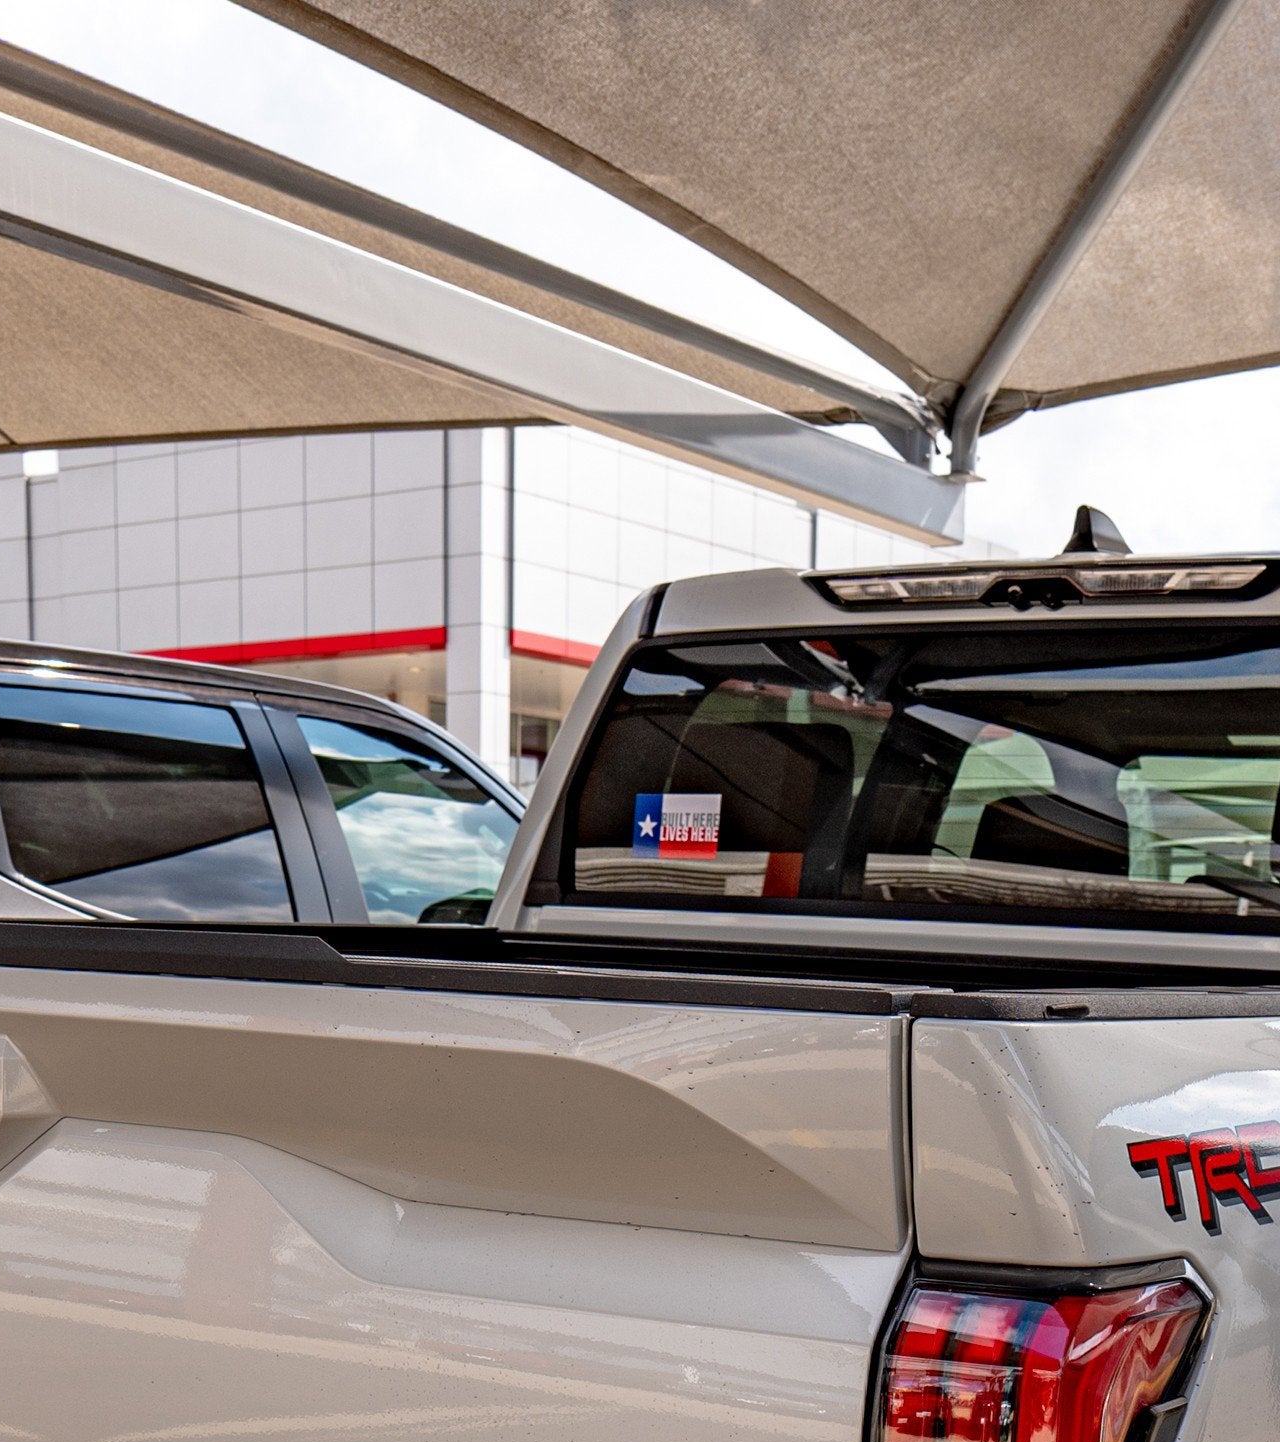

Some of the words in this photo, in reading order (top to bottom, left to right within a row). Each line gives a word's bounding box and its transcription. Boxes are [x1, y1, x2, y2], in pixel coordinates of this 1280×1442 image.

[662, 813, 691, 828] BUILT
[693, 813, 720, 828] HERE
[660, 826, 689, 842] LIVES
[691, 827, 719, 842] HERE
